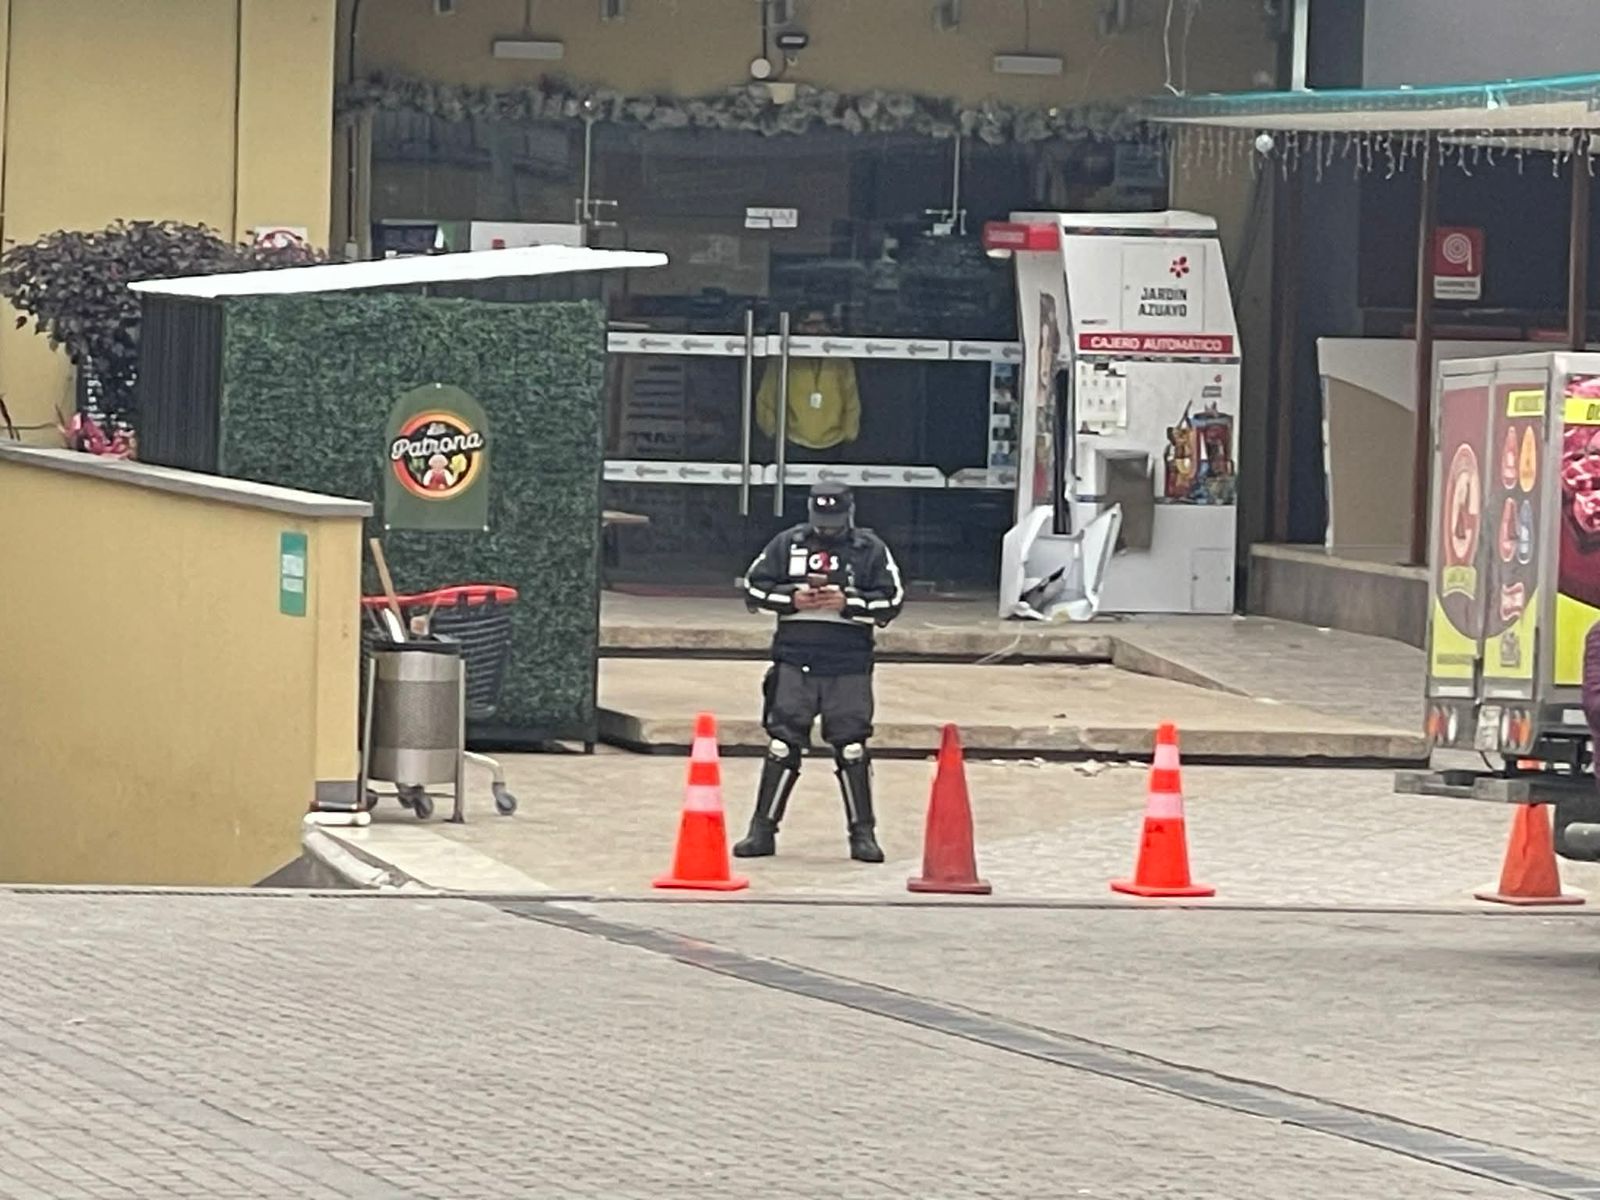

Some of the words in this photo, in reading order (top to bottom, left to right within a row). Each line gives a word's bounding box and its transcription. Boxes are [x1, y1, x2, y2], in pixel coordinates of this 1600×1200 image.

[1138, 303, 1187, 317] AZUAYO
[1090, 336, 1140, 350] CAJERO
[391, 433, 483, 459] Patrona
